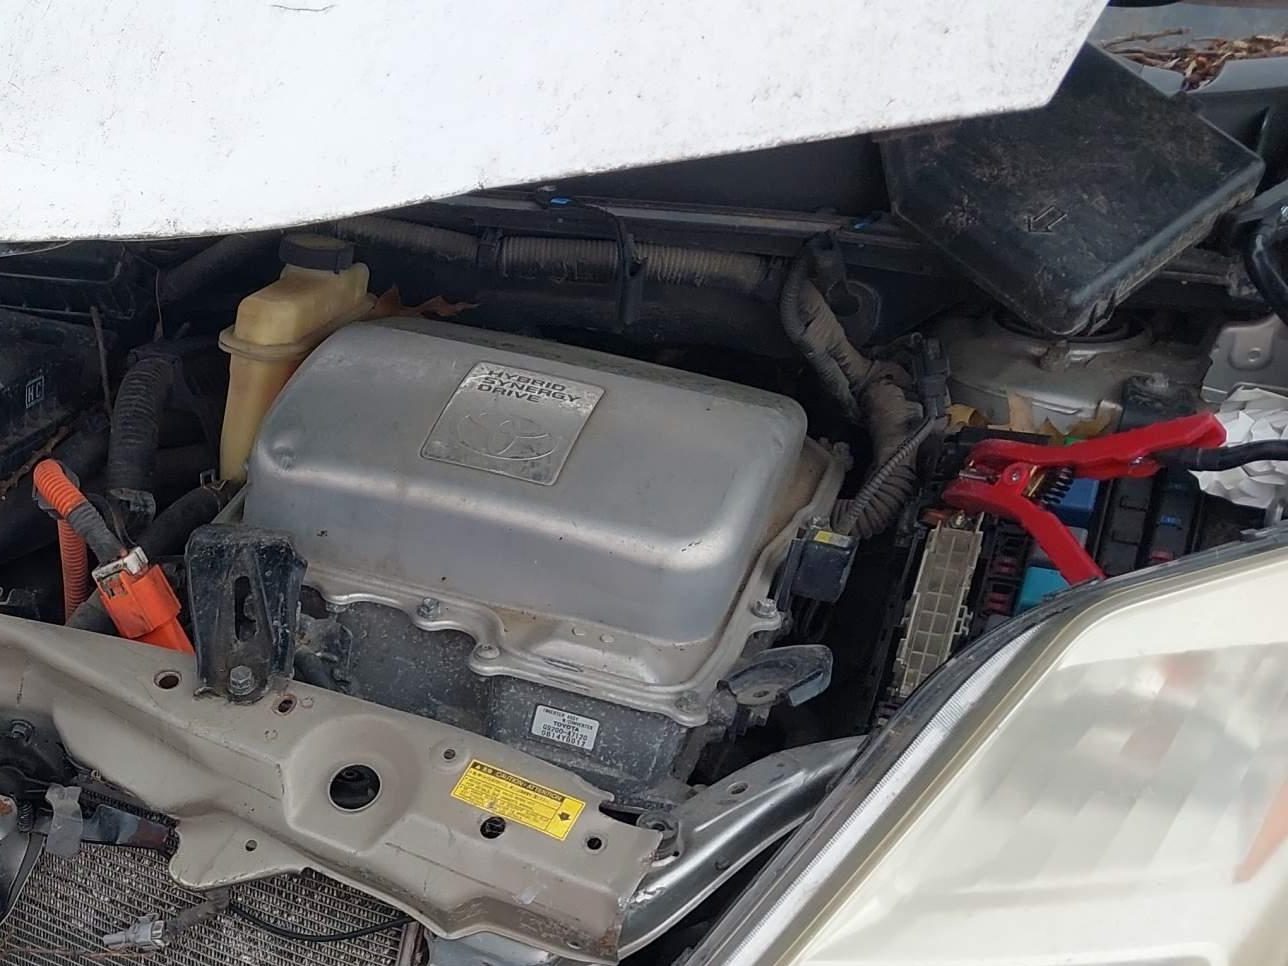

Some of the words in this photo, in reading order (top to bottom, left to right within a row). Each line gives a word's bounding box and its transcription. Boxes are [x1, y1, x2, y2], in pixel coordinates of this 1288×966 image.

[482, 377, 582, 402] SYNERGY
[488, 371, 566, 391] HYBRID
[477, 384, 541, 402] DRIVE
[553, 721, 579, 732] TOYOTA
[495, 771, 525, 786] CAUTION
[527, 784, 563, 801] ATTENTION
